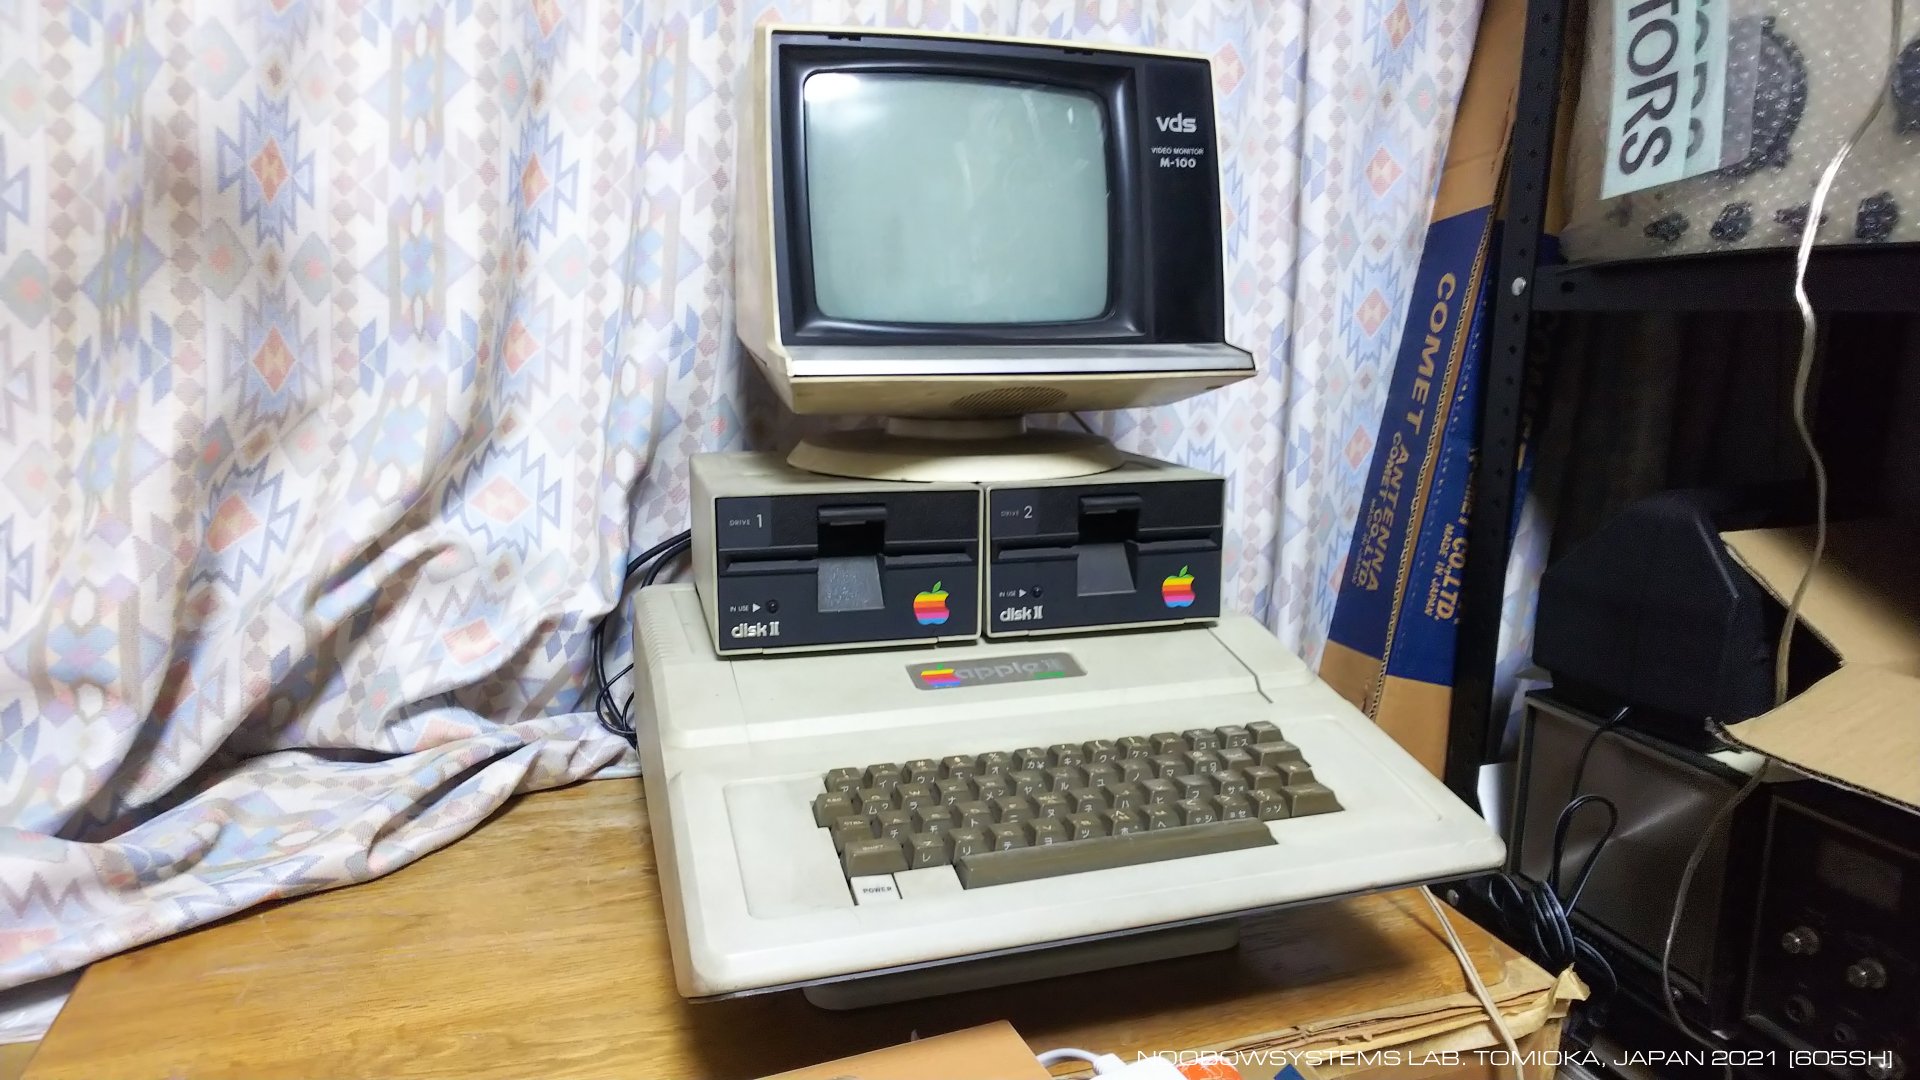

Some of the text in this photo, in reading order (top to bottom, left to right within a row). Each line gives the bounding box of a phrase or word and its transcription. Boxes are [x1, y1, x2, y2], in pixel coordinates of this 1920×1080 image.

[1155, 112, 1197, 133] vds
[1173, 147, 1204, 155] MONITOR
[1160, 157, 1197, 168] M-100
[1366, 272, 1456, 591] COMET ANTENNA
[1379, 431, 1402, 502] COMET
[1023, 505, 1033, 519] 2
[729, 513, 763, 529] DRIVE 1
[1440, 523, 1454, 558] MADE
[730, 604, 749, 613] IN USE
[1000, 606, 1032, 622] disk
[731, 622, 768, 638] disk
[954, 662, 1039, 680] apple
[862, 886, 892, 894] POWER
